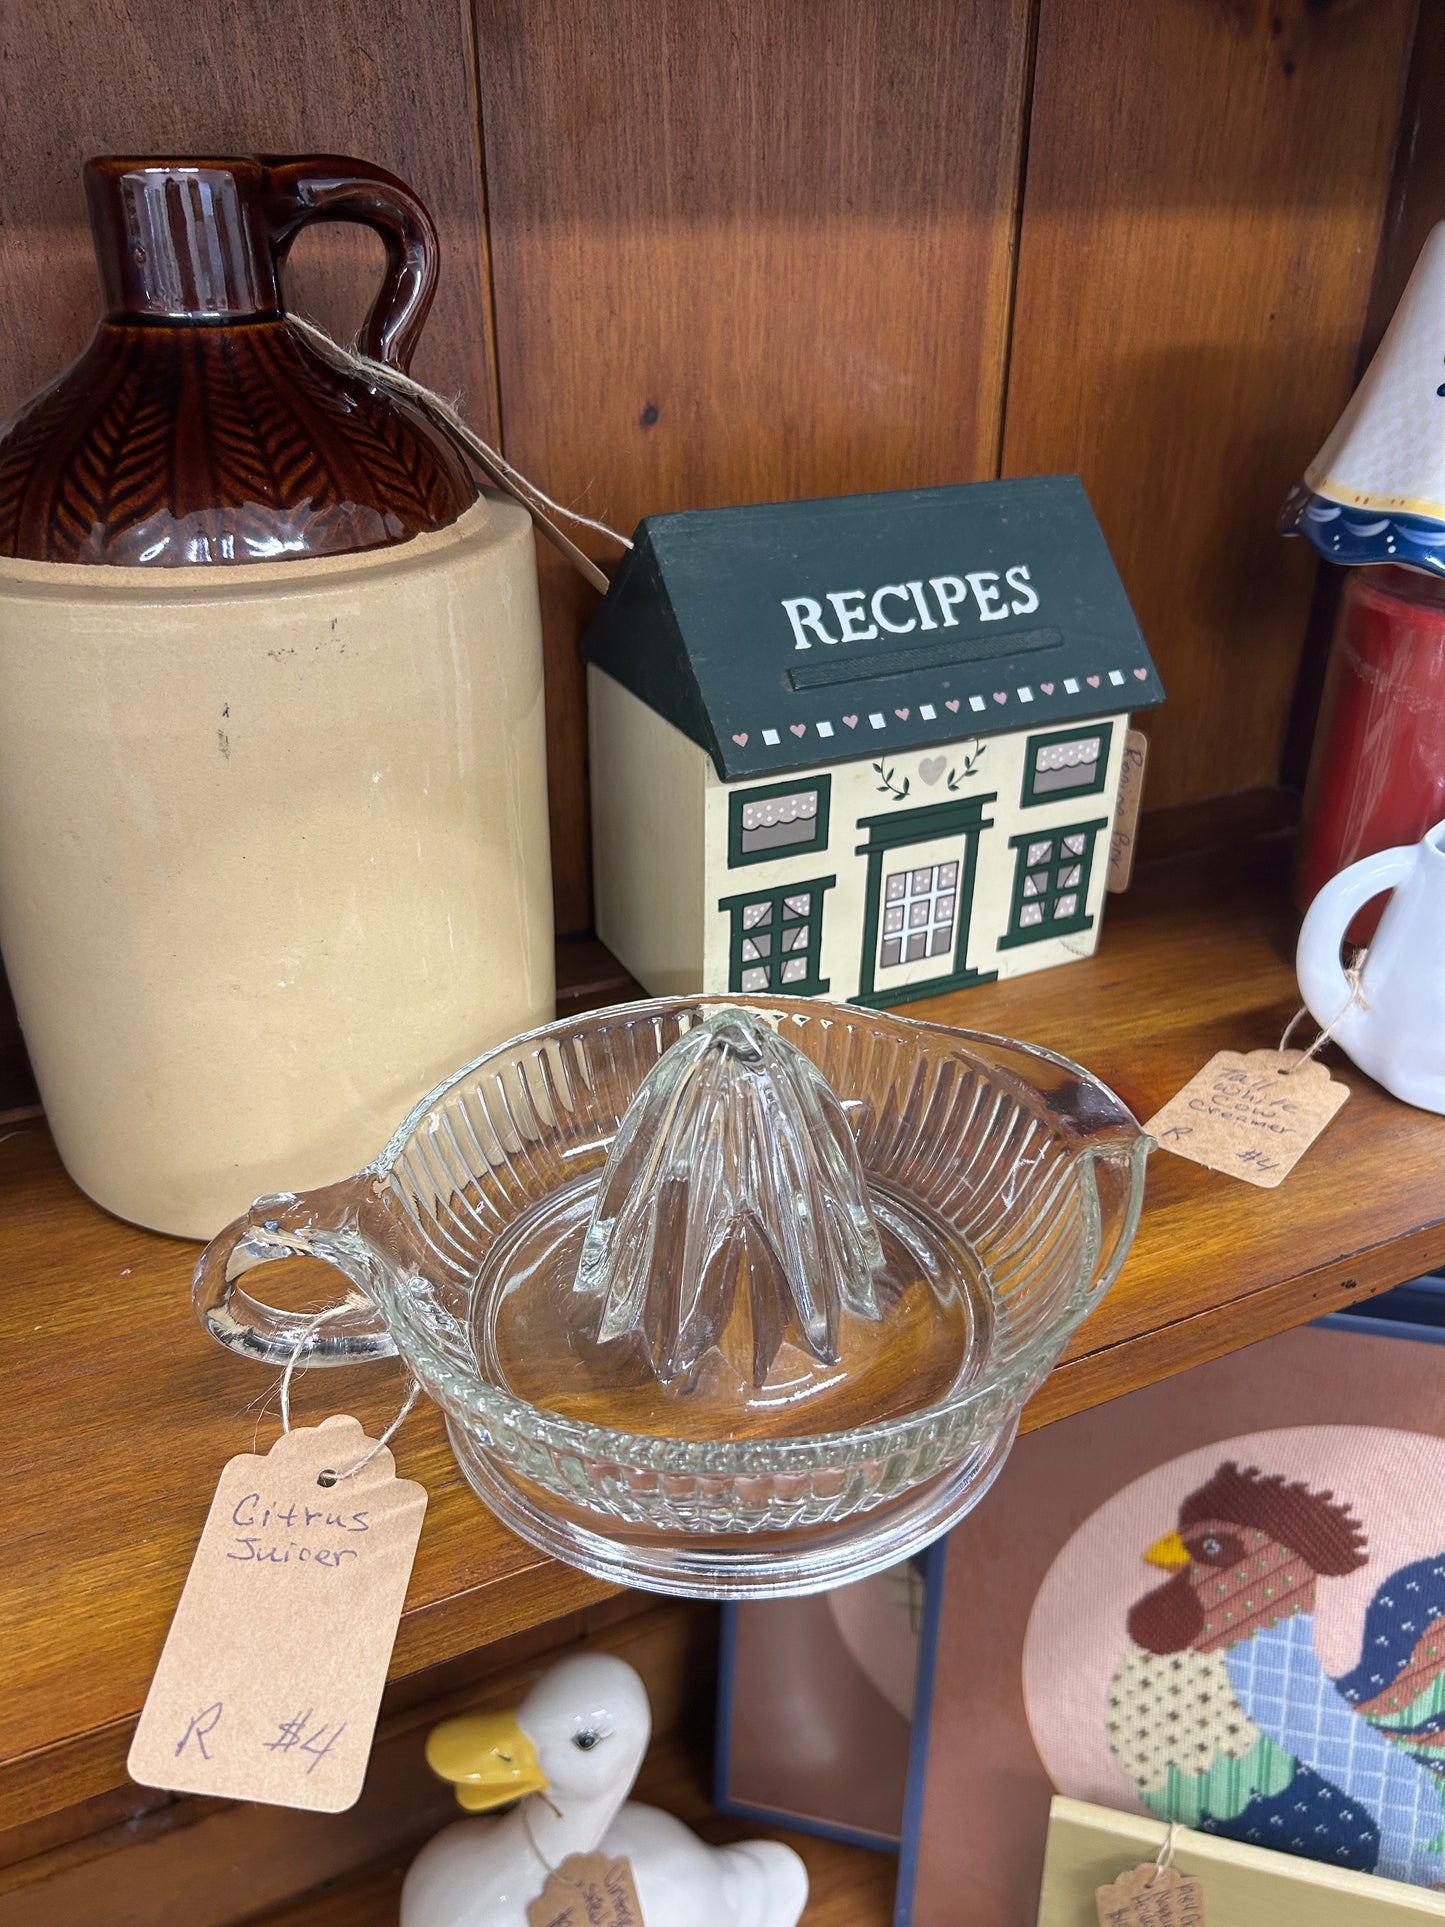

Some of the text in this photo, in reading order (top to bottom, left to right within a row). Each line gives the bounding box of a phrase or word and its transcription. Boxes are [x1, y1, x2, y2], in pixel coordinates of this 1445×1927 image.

[781, 564, 1040, 650] RECIPES
[1218, 1066, 1279, 1091] Tall
[1188, 1098, 1297, 1134] Creamer
[1211, 1094, 1277, 1118] Cow
[1162, 1127, 1193, 1141] R
[232, 1492, 370, 1532] Citrus
[226, 1536, 358, 1567] Juicer
[174, 1701, 348, 1775] R $4
